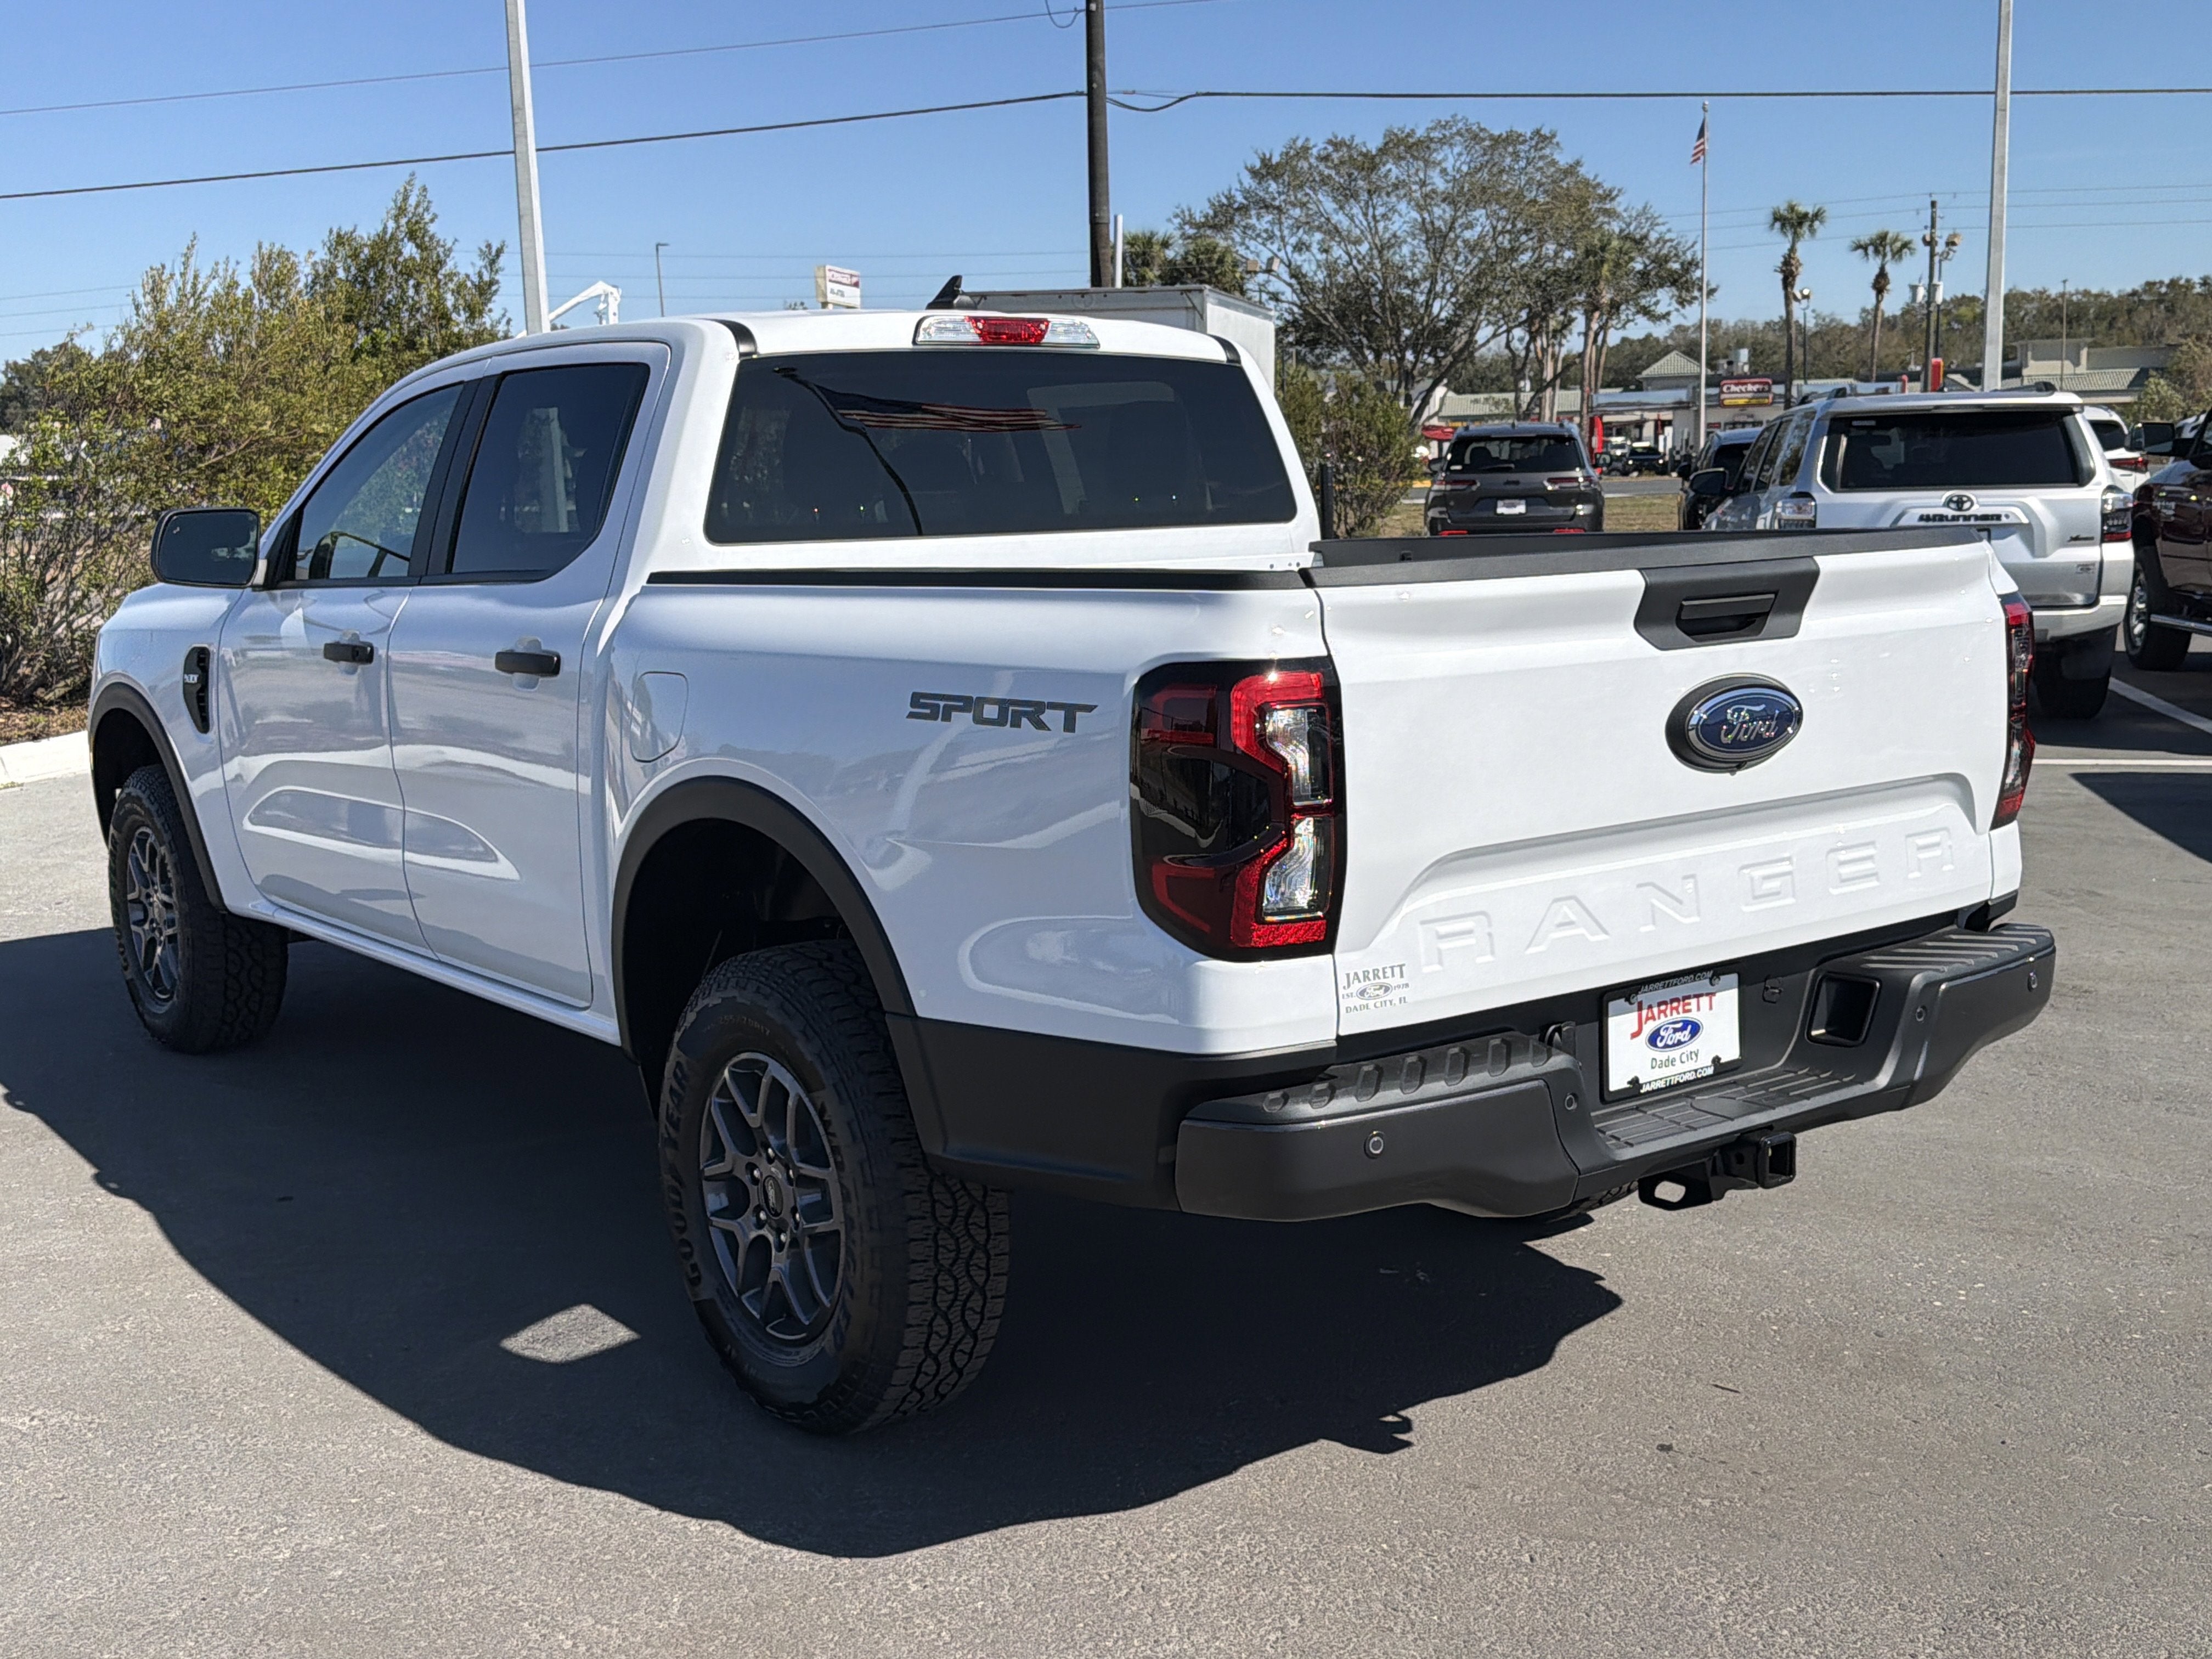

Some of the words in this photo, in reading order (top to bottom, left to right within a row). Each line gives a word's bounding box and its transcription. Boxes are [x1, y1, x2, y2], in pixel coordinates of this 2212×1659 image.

[906, 691, 1098, 733] SPORT
[1419, 827, 1954, 973] RANGER
[1342, 963, 1406, 990] JARRETT
[1345, 1003, 1370, 1014] DADE
[1630, 992, 1716, 1040] JARRETT
[1656, 1022, 1691, 1047] Ford
[1650, 1056, 1677, 1070] Dade
[1679, 1048, 1699, 1064] City
[1640, 1065, 1714, 1093] JARRETTFORD.COM
